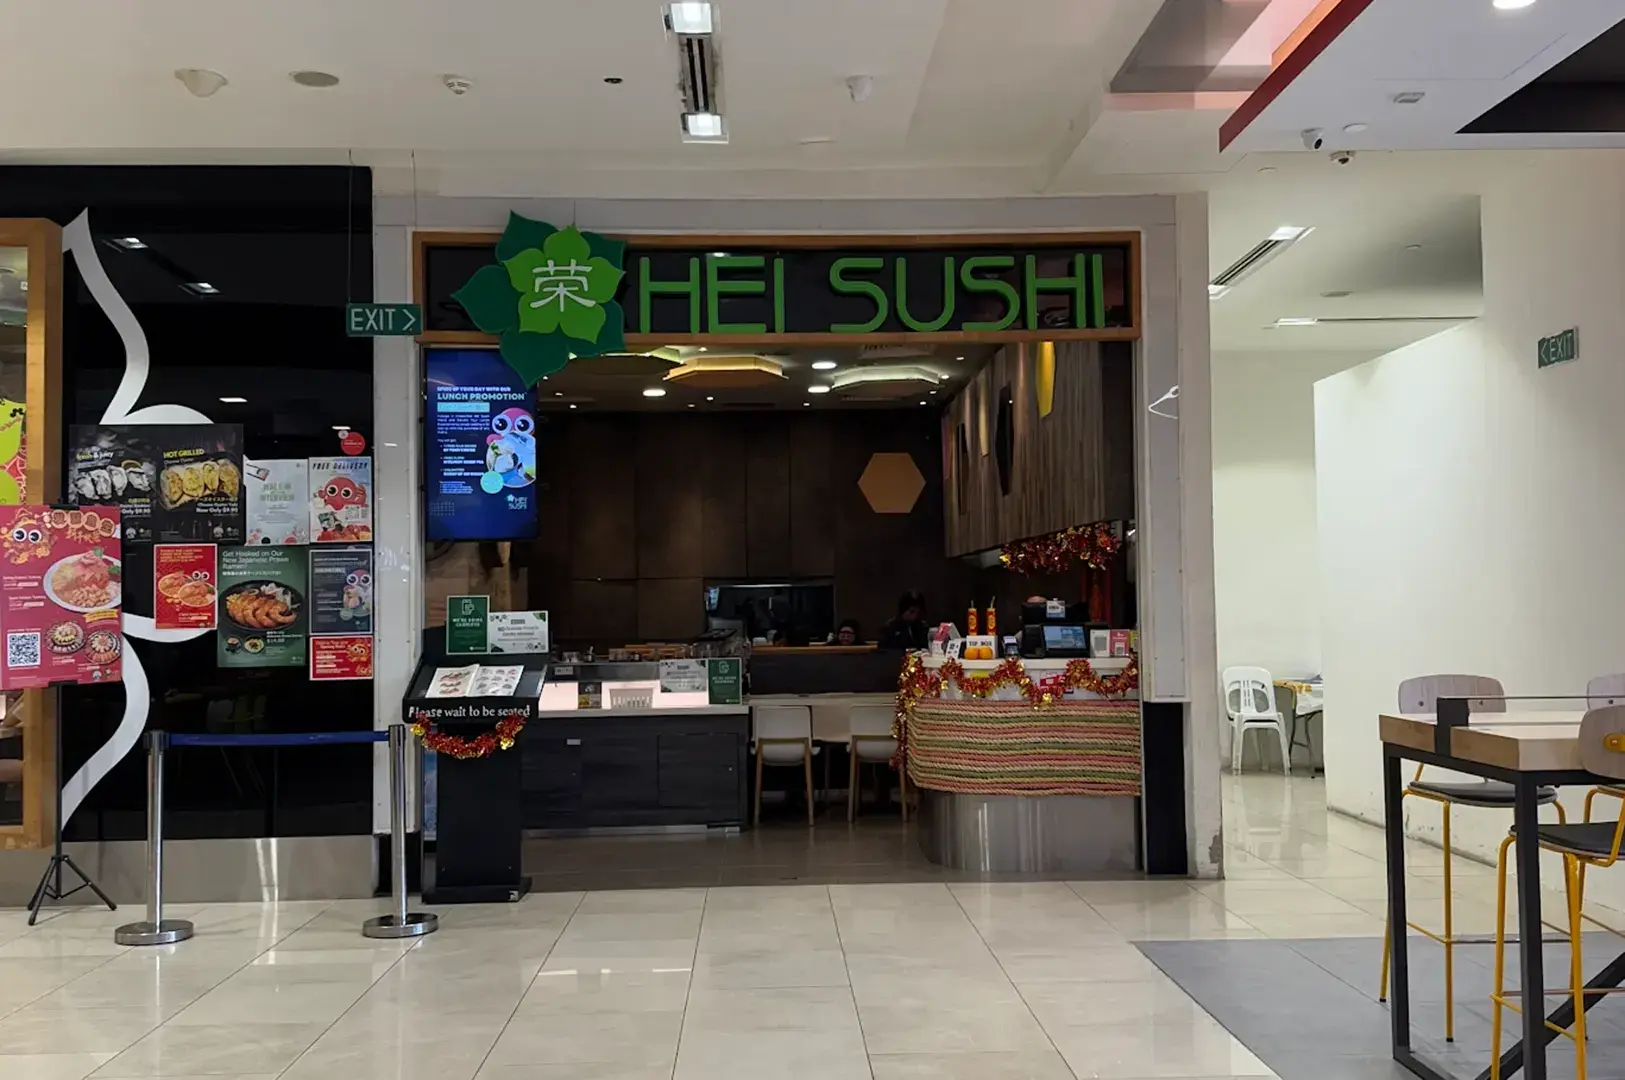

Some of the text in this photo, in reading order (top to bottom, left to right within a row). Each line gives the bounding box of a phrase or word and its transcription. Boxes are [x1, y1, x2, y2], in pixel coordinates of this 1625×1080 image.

[530, 259, 596, 312] 荣
[639, 253, 1106, 334] HEI SUSHI
[350, 308, 396, 332] EXIT
[1550, 332, 1572, 361] EXIT
[437, 392, 468, 400] LUNCH
[178, 448, 205, 457] GRILLED
[408, 705, 530, 719] Please wait to be seated
